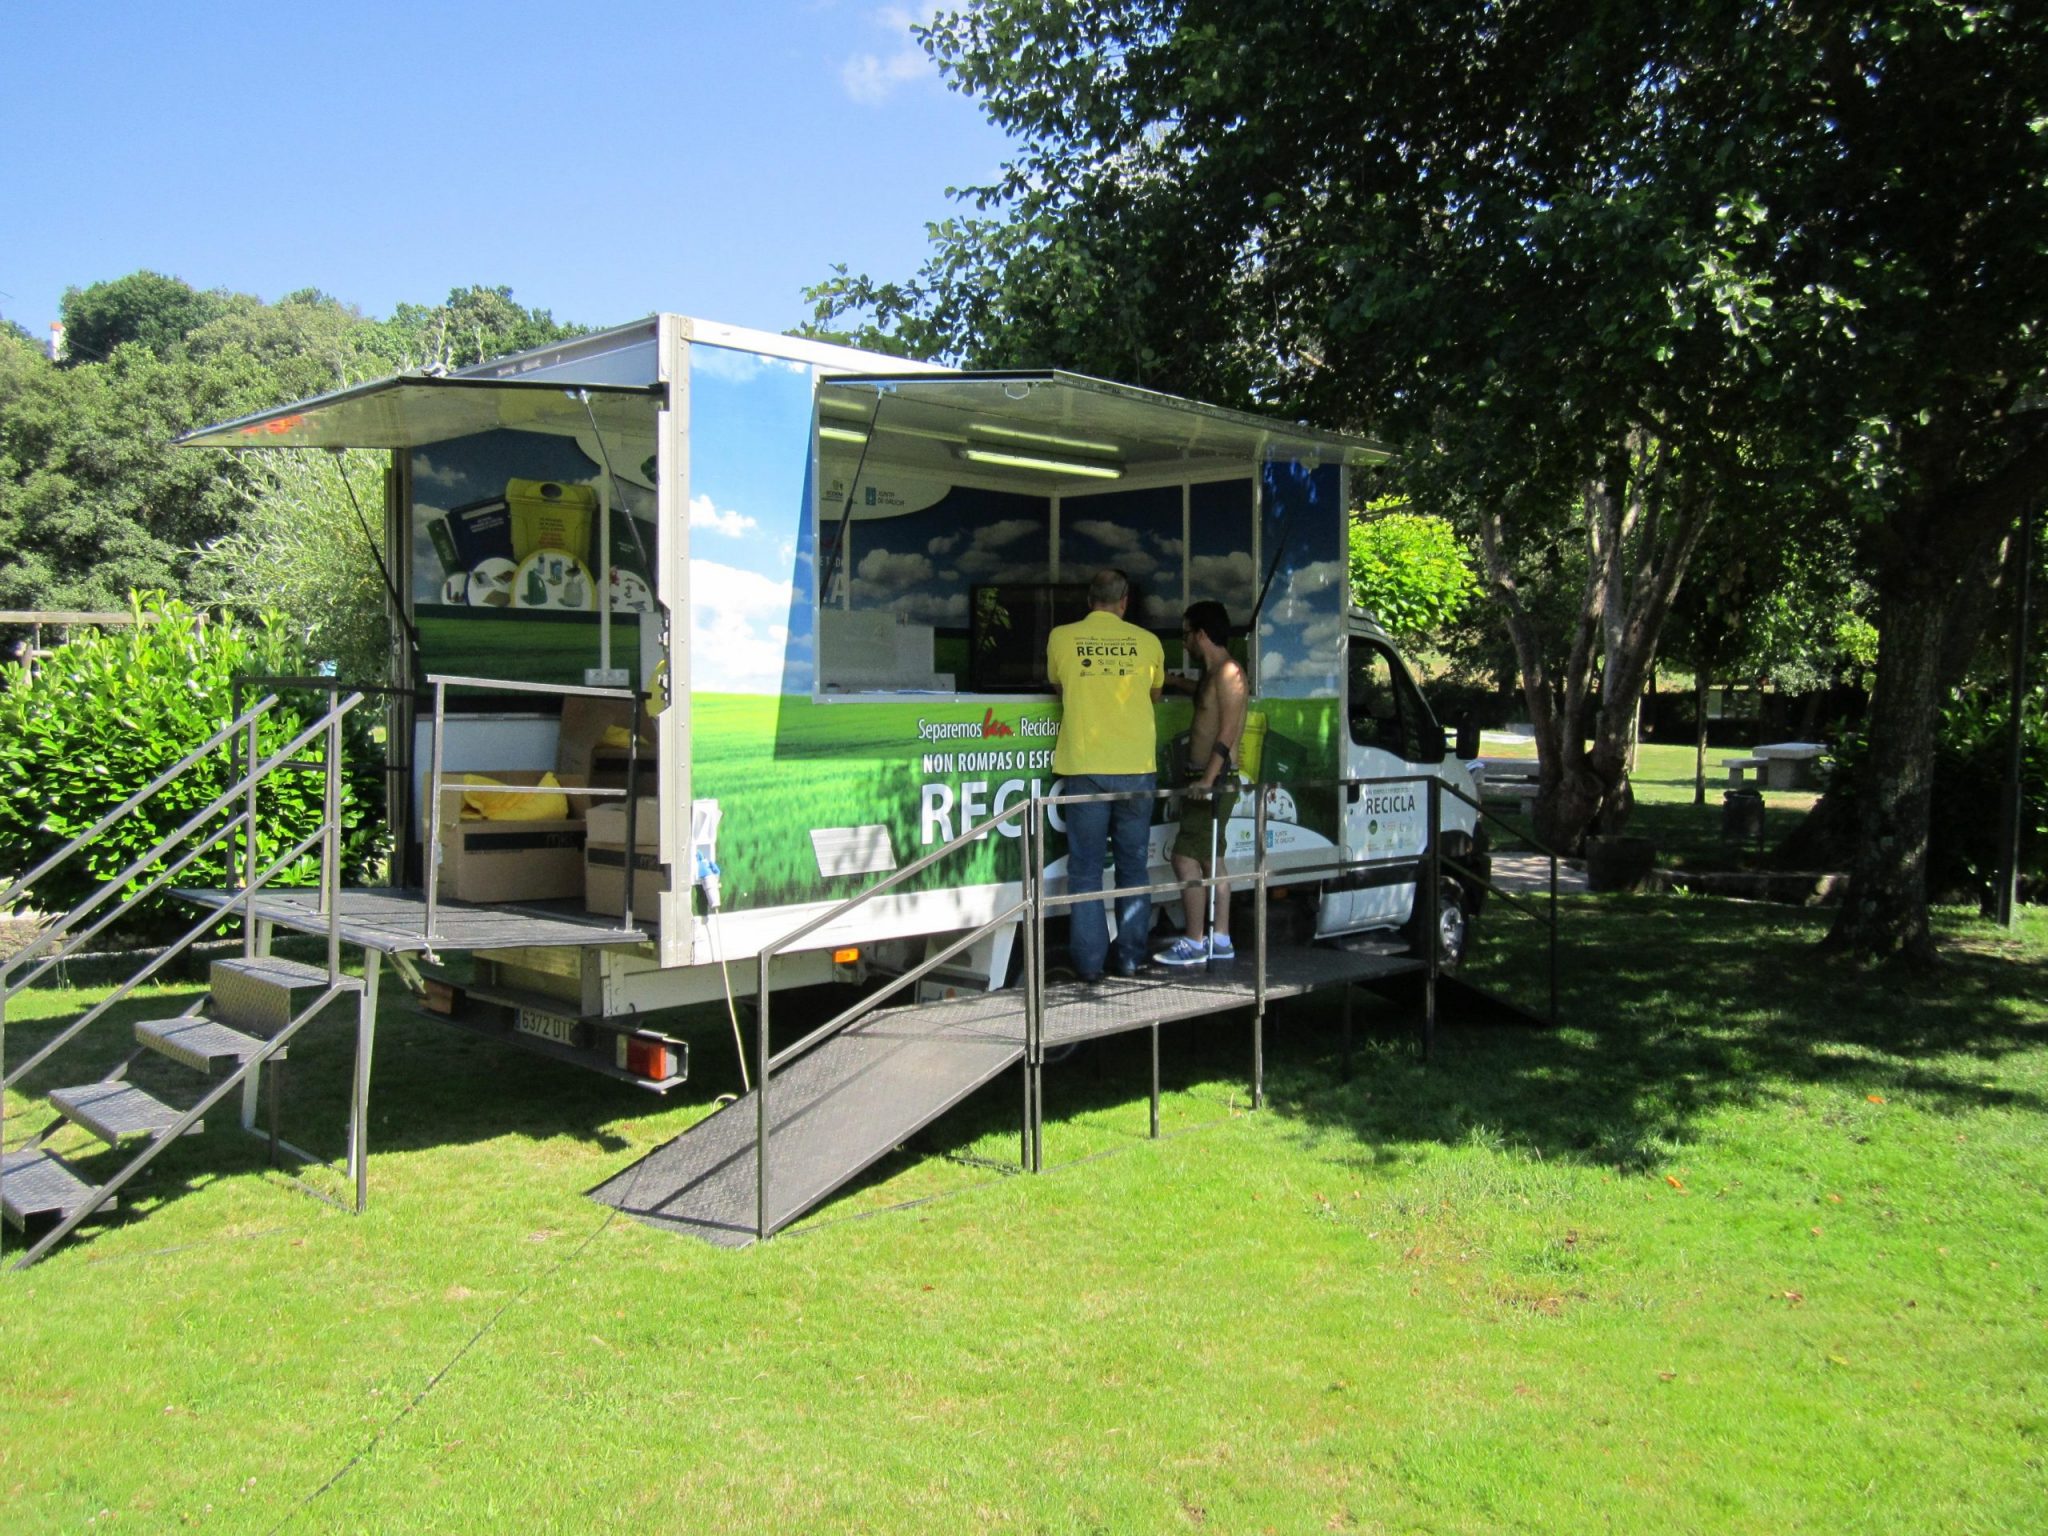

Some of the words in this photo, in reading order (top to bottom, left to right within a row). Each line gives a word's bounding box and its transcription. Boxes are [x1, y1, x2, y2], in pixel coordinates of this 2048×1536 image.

[1077, 646, 1138, 656] RECICLA
[919, 718, 982, 744] Separemos
[923, 754, 953, 774] NON
[958, 751, 1012, 772] ROMPAS
[1016, 751, 1025, 769] O
[1366, 794, 1416, 815] RECICLA
